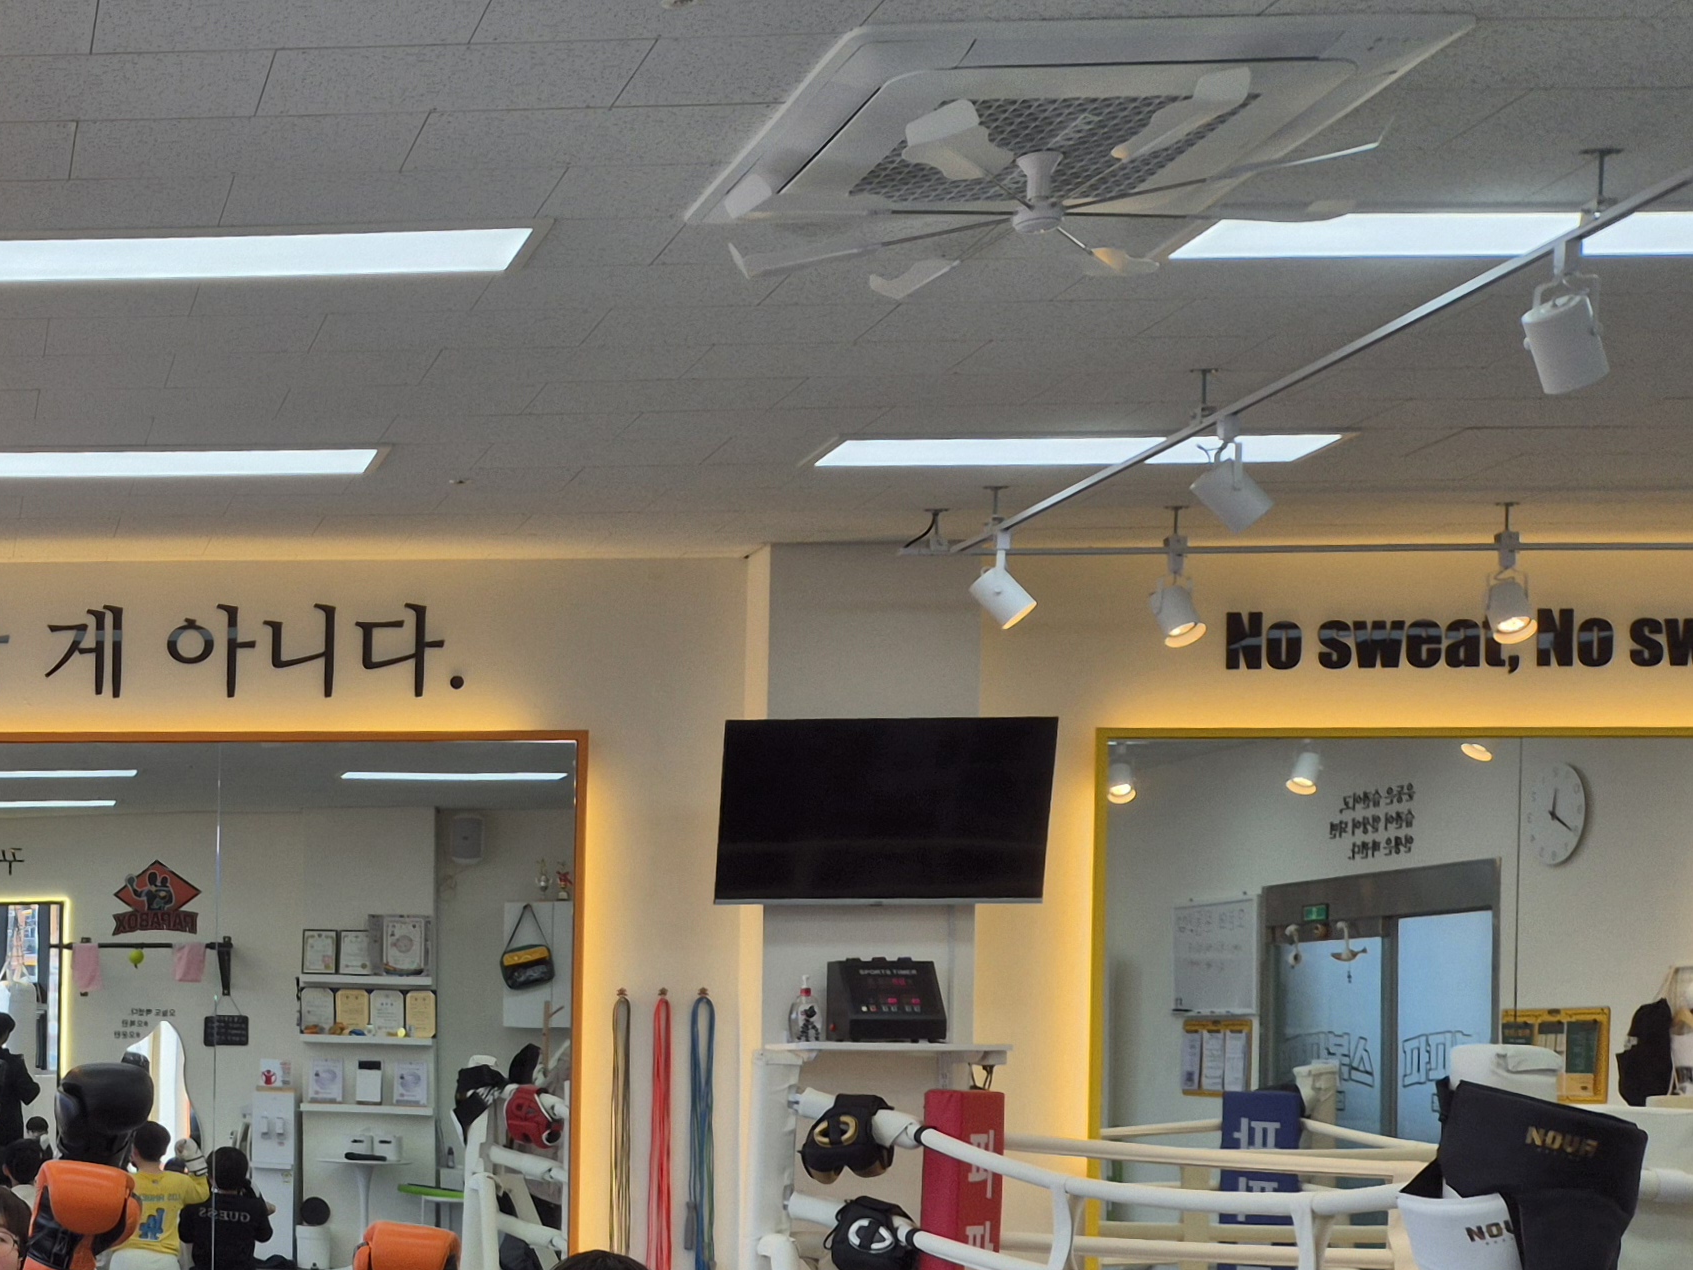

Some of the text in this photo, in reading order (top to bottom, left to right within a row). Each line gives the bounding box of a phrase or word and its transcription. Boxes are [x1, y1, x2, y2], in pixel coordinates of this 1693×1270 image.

[44, 604, 125, 699] 게
[166, 602, 466, 699] 아니다.
[1225, 610, 1303, 671] No
[1317, 618, 1520, 675] sweat,
[1536, 607, 1614, 668] No
